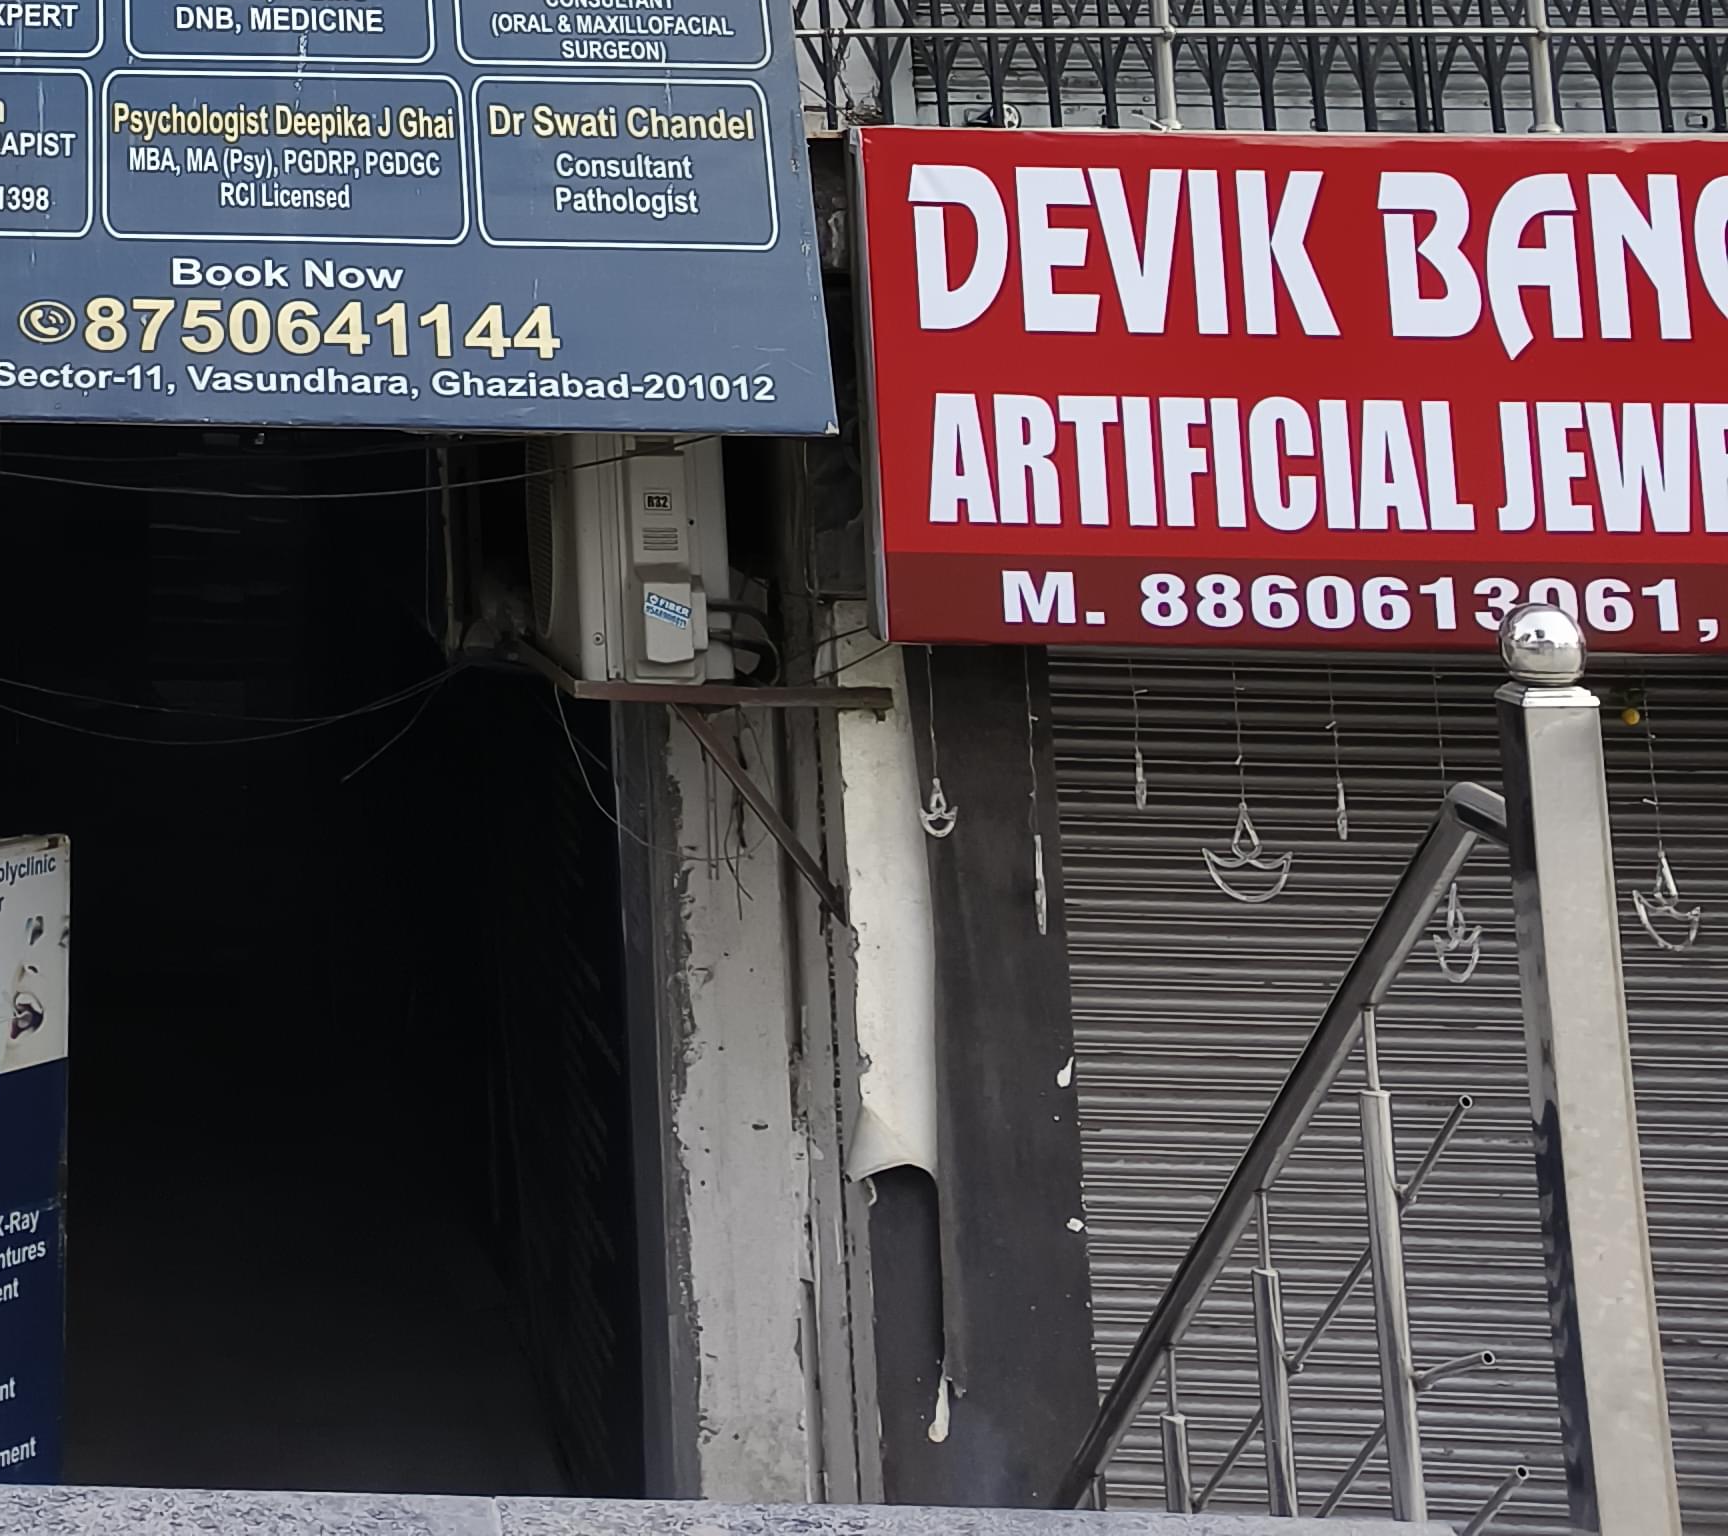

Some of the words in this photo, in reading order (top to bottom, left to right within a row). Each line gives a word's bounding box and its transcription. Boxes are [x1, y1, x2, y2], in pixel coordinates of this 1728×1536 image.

[561, 40, 667, 63] SURGEON)
[115, 103, 268, 142] Psychologist
[276, 105, 371, 143] Deepika
[378, 108, 390, 136] J
[399, 108, 454, 138] Ghai
[490, 105, 524, 135] Dr
[534, 106, 616, 136] Swati
[628, 108, 754, 139] Chandel
[557, 153, 692, 178] Consultant
[221, 183, 255, 206] RCI
[262, 183, 349, 208] Licensed
[556, 187, 698, 218] Pathologist
[908, 164, 1340, 335] DEVIK
[173, 258, 288, 286] Book
[305, 260, 403, 288] Now
[86, 298, 560, 358] 8750641144
[188, 366, 418, 399] Vasundhara,
[432, 371, 774, 400] Ghaziabad-201012
[930, 393, 1475, 530] ARTIFICIAL
[1002, 571, 1105, 624] M.
